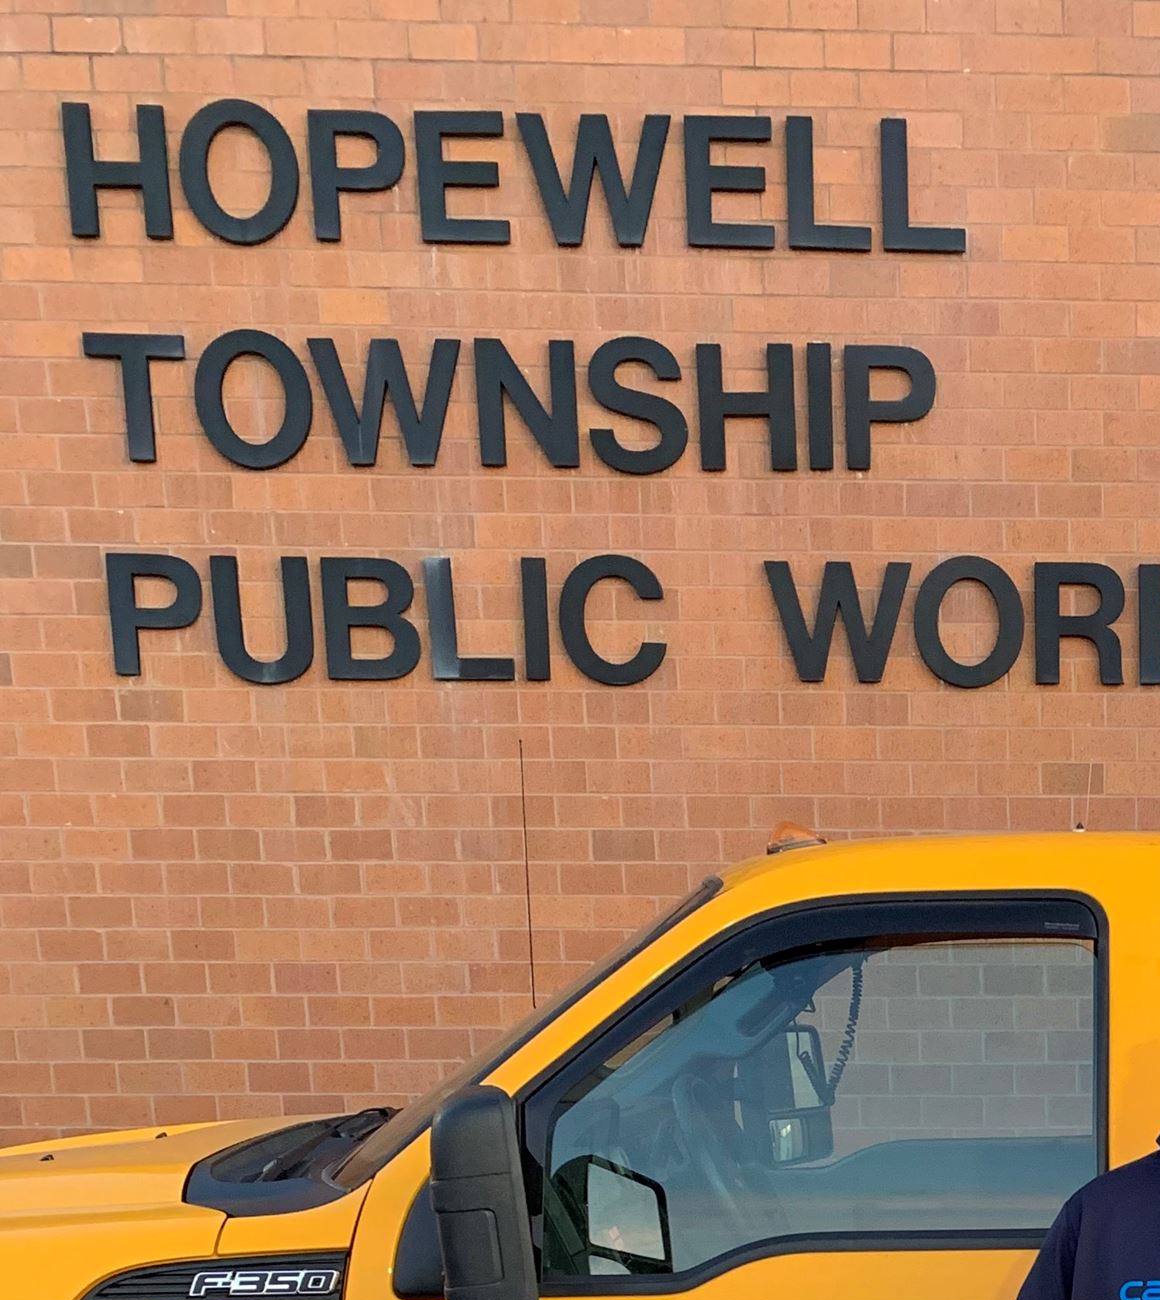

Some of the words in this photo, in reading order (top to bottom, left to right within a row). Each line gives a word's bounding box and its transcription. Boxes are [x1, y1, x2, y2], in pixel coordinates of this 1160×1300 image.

[61, 99, 966, 254] HOPEWELL
[82, 328, 937, 474] TOWNSHIP
[105, 553, 667, 686] PUBLIC
[189, 1269, 340, 1297] F-350
